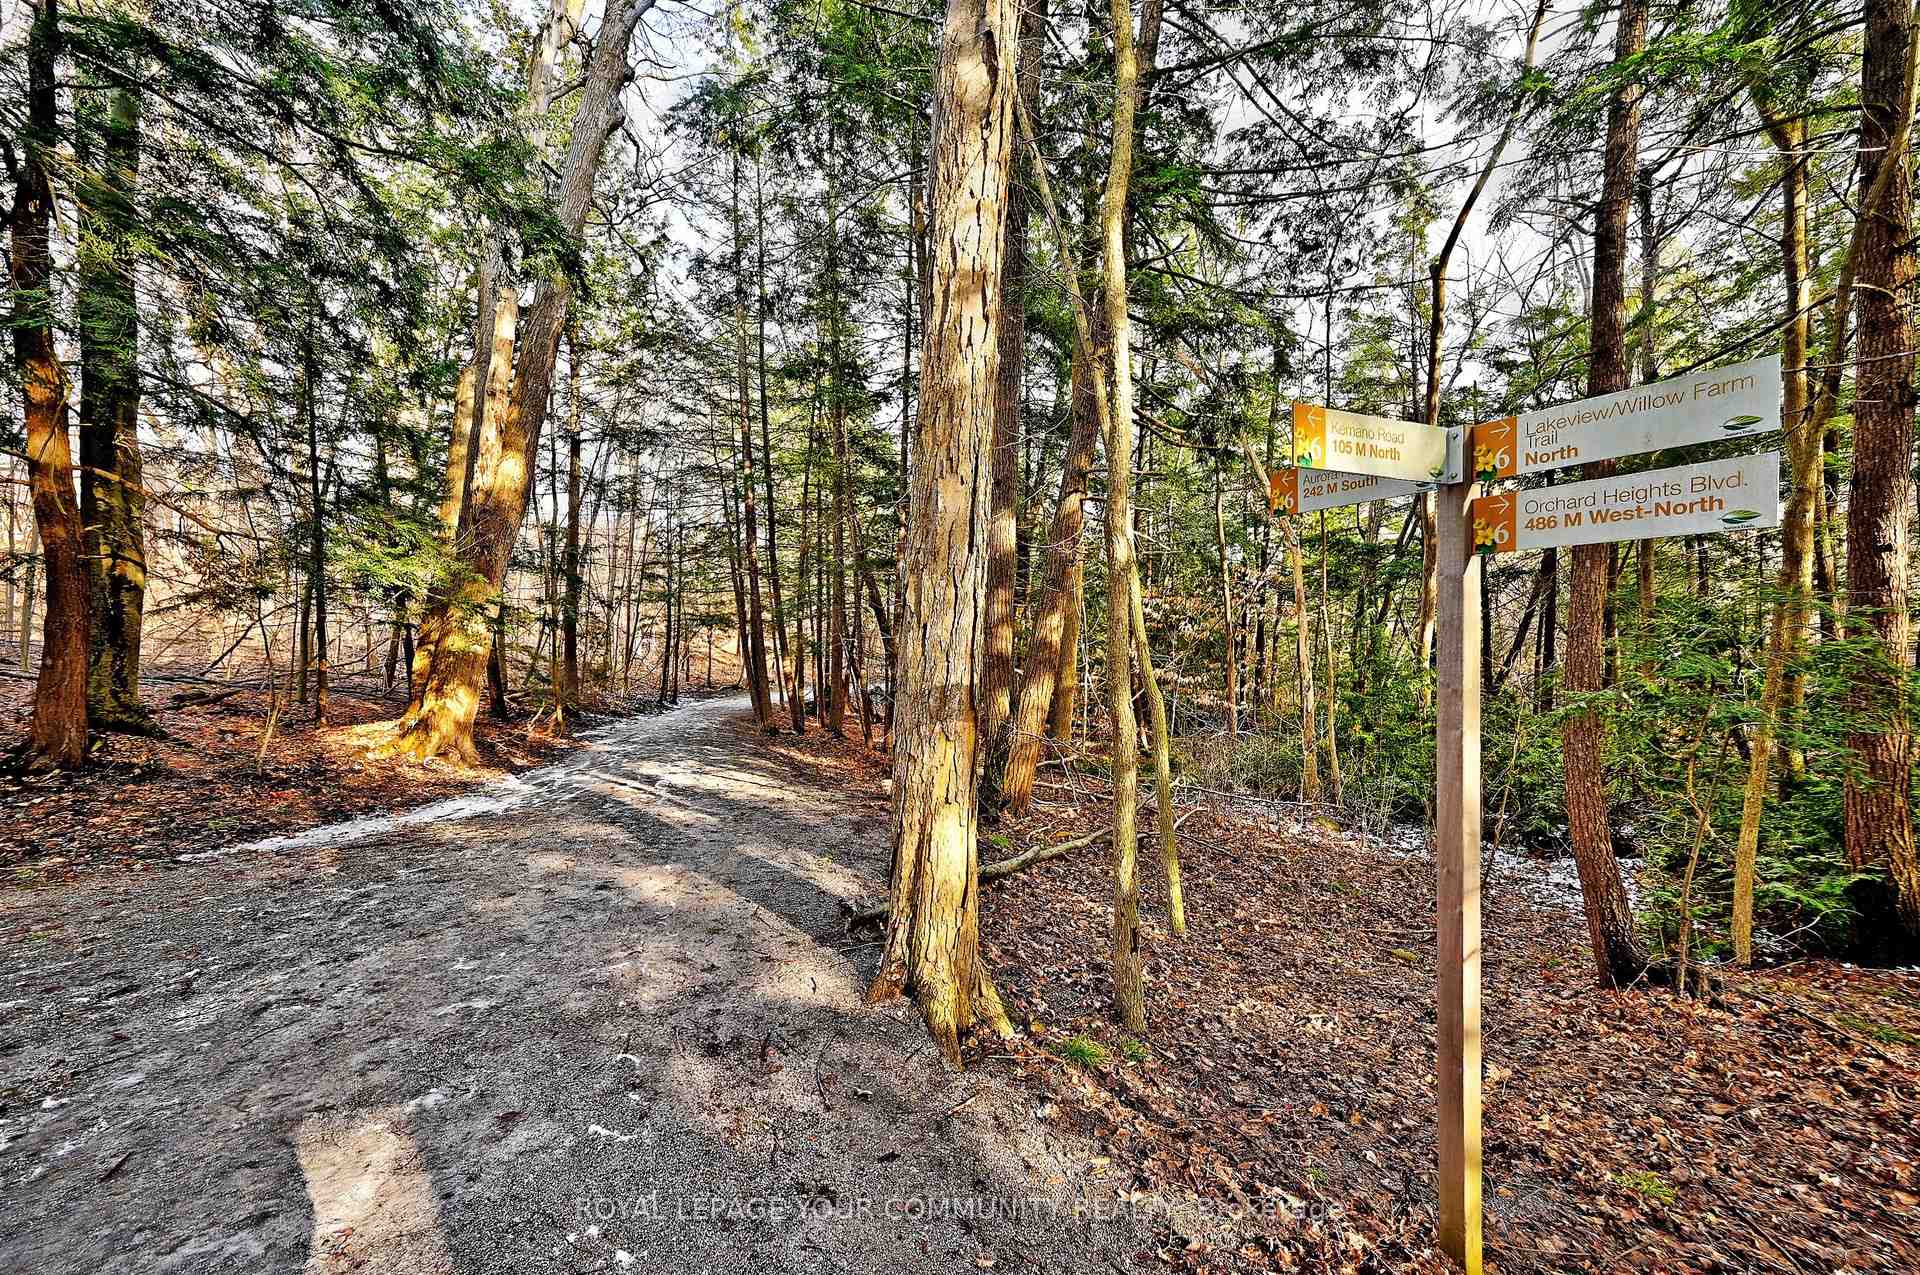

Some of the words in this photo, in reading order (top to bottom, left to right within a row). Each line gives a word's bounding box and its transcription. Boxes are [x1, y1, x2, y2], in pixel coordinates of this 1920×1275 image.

[1526, 391, 1685, 436] Lakeview/Willow
[1694, 375, 1755, 401] Farm
[1377, 426, 1405, 444] Road
[1526, 430, 1559, 449] Trail
[1333, 439, 1353, 455] 105
[1355, 441, 1366, 457] M
[1369, 444, 1401, 462] North
[1494, 445, 1511, 470] 6
[1524, 444, 1579, 467] North
[1303, 485, 1324, 499] 242
[1327, 481, 1338, 495] M
[1341, 475, 1378, 492] South
[1524, 491, 1597, 515] Orchard
[1603, 481, 1683, 505] Heights
[1690, 470, 1749, 494] Blvd.
[1524, 515, 1559, 532] 486
[1564, 511, 1583, 529] M
[1589, 495, 1726, 525] West-North
[1493, 520, 1510, 545] 6
